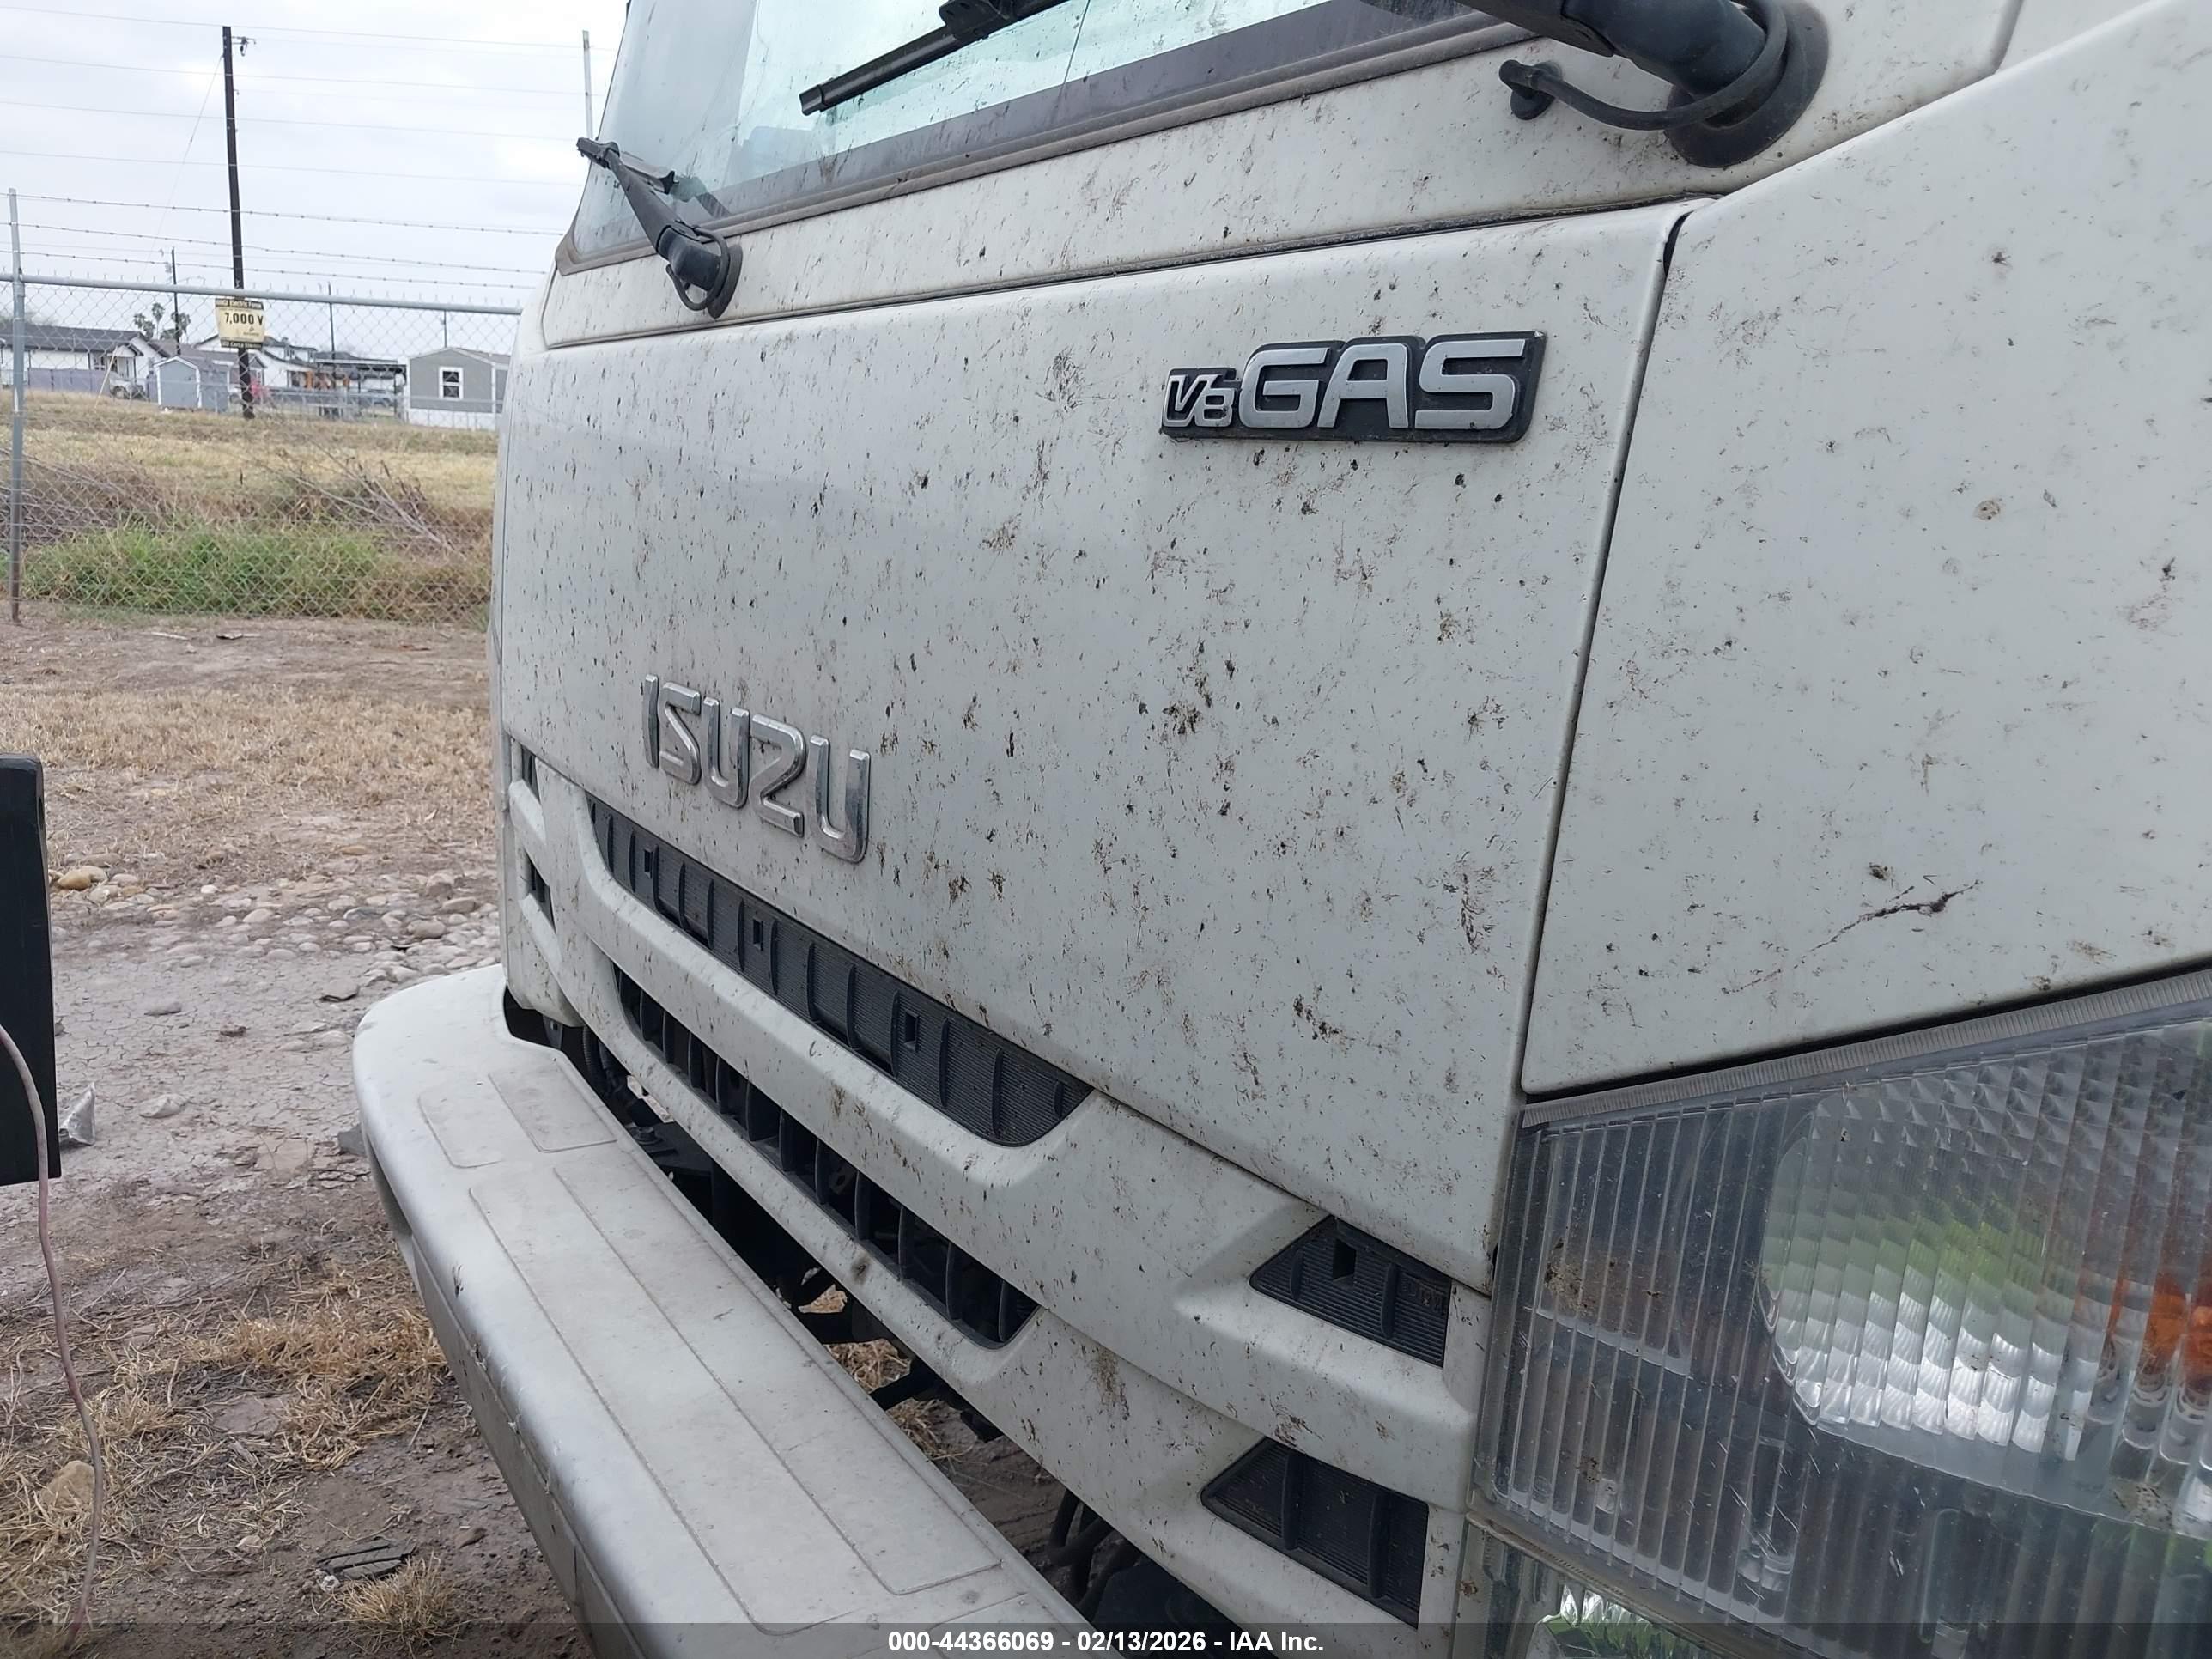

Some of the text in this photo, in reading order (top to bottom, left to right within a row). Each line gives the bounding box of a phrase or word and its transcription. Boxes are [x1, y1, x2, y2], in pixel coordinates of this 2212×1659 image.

[225, 312, 264, 325] 7,000 V
[1163, 338, 1526, 429] V8 GAS
[644, 673, 871, 864] ISUZU
